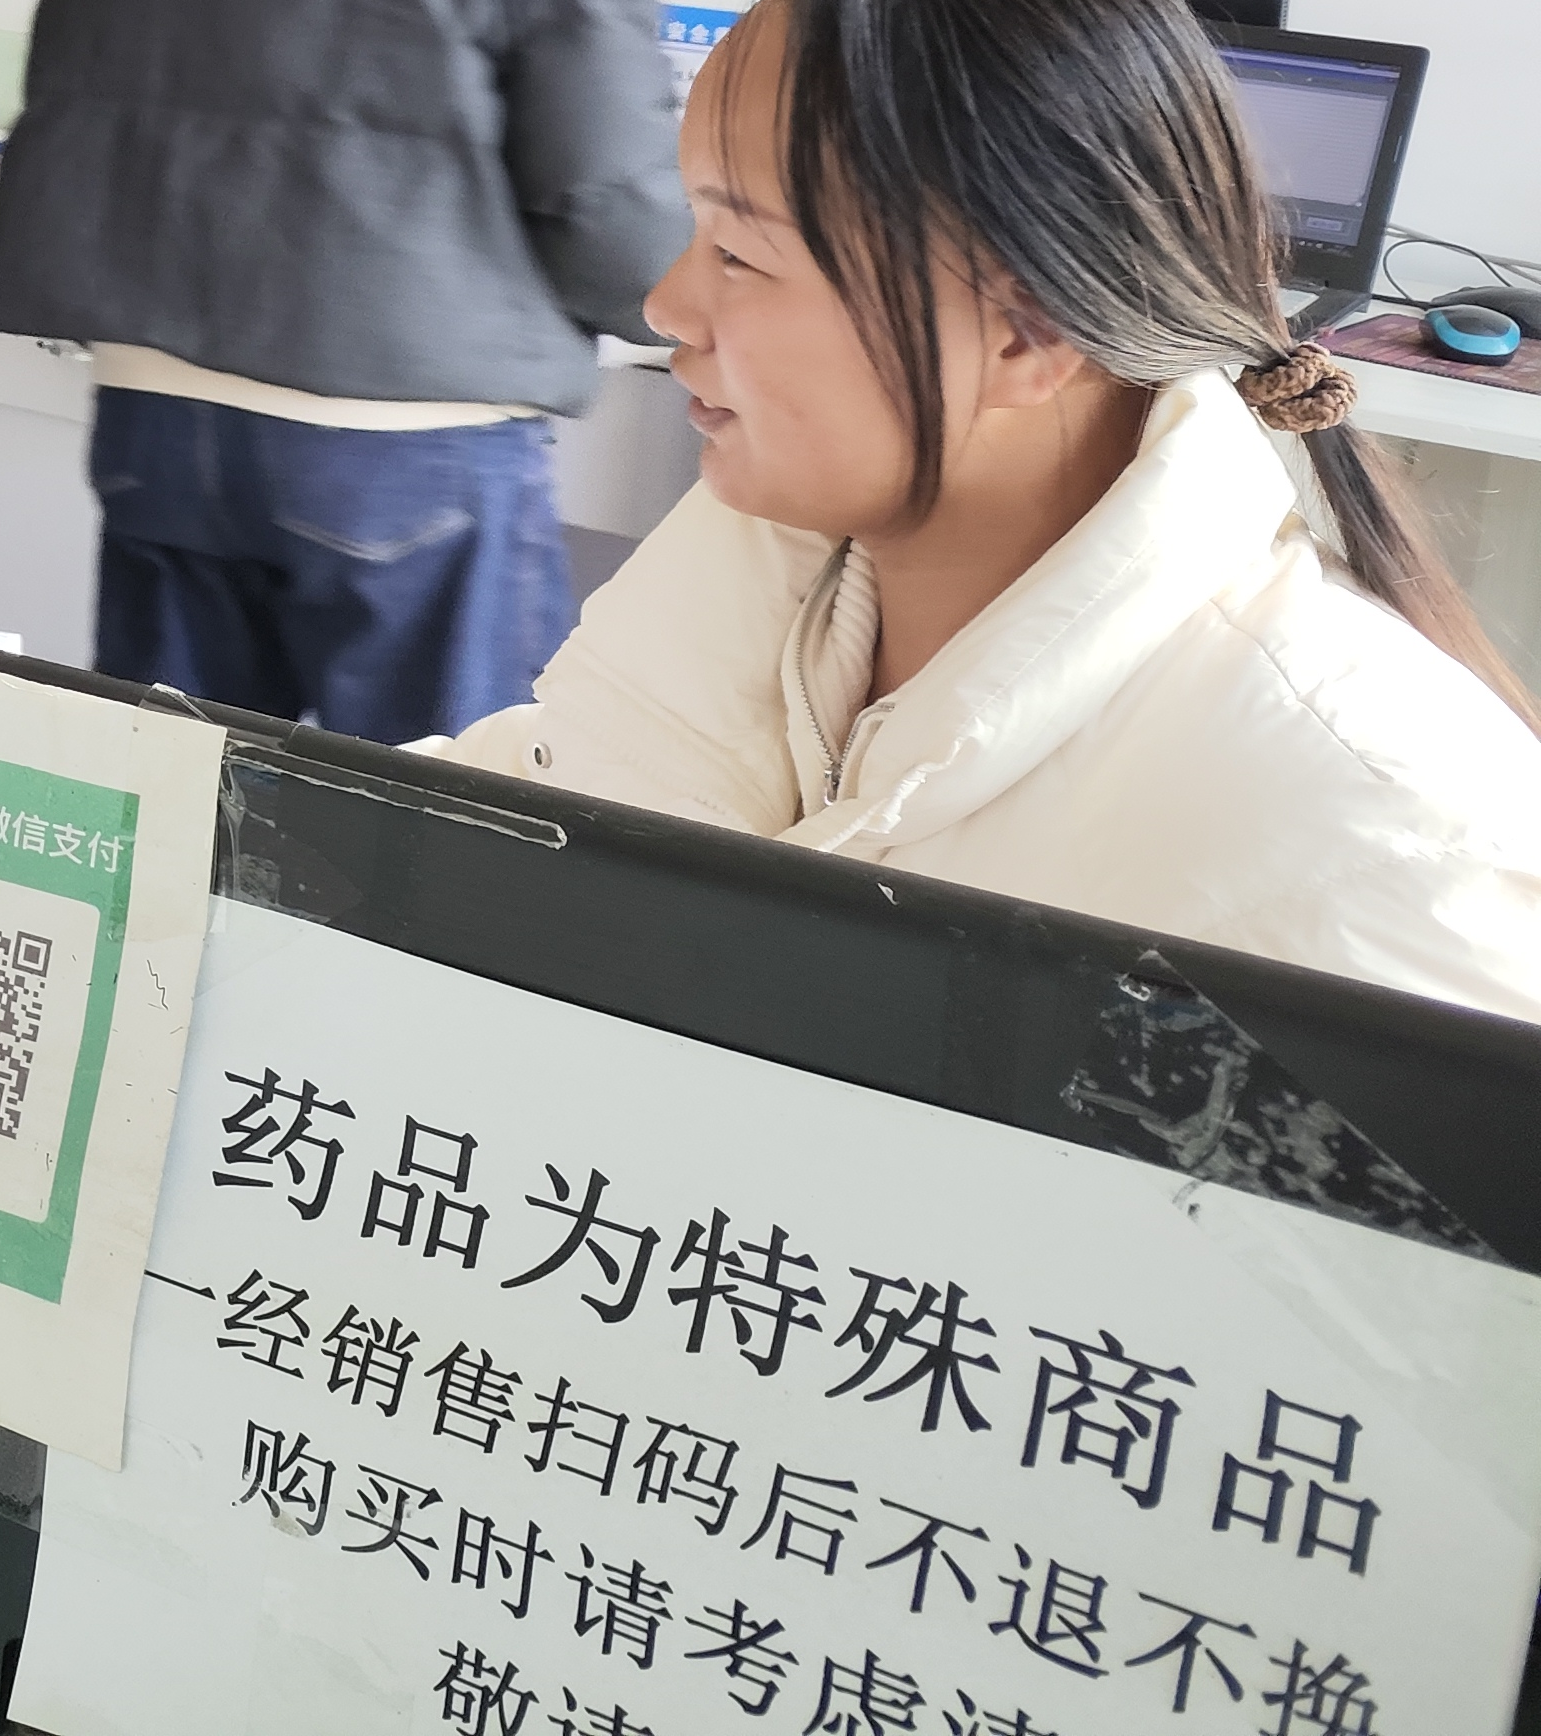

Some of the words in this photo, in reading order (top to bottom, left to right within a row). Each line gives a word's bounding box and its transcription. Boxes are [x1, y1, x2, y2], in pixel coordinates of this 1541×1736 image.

[142, 1265, 1381, 1736] 一经销售扫码后不退不换
[209, 1063, 1382, 1576] 药品为特殊商品
